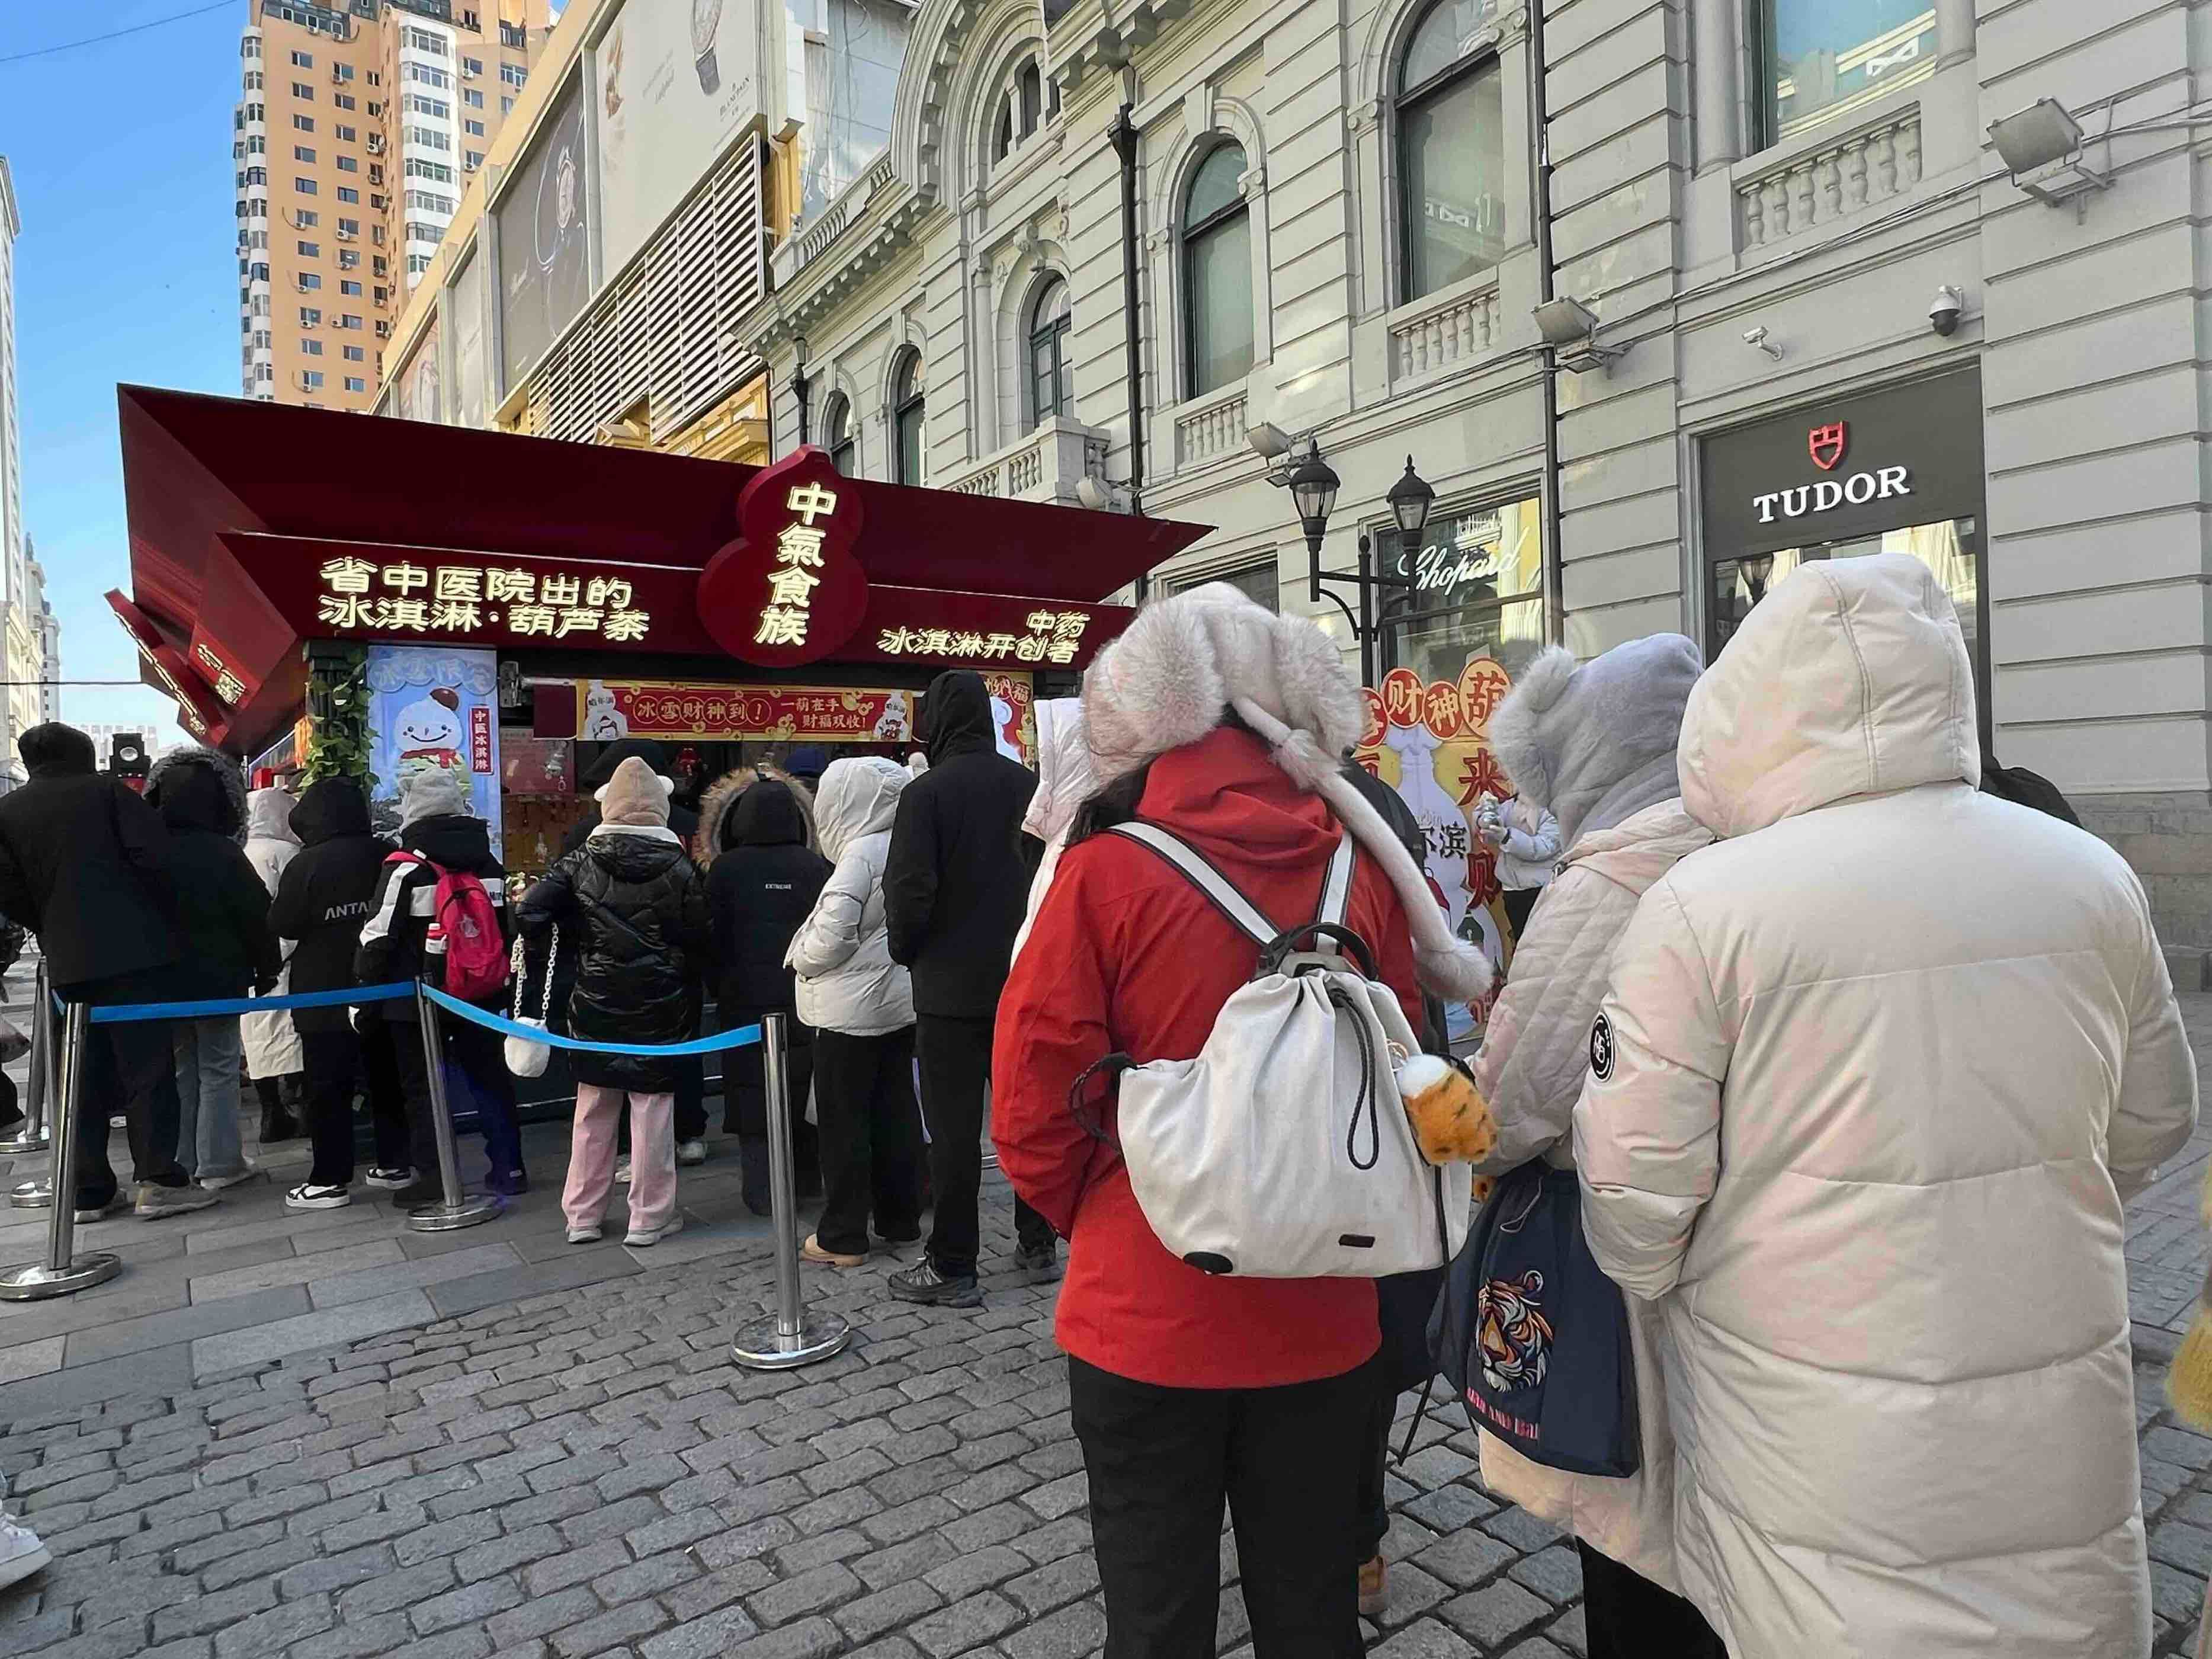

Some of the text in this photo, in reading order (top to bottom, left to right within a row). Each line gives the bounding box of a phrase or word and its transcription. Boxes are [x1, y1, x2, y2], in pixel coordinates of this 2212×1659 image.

[1753, 465, 1911, 524] TUDOR
[318, 556, 633, 608] 省中医院出的
[754, 482, 836, 646] 中氣食族
[1397, 526, 1527, 596] Chopard
[876, 625, 1080, 664] 冰淇淋开创者
[1026, 609, 1091, 640] 中药
[1361, 671, 1506, 744] 财神葫
